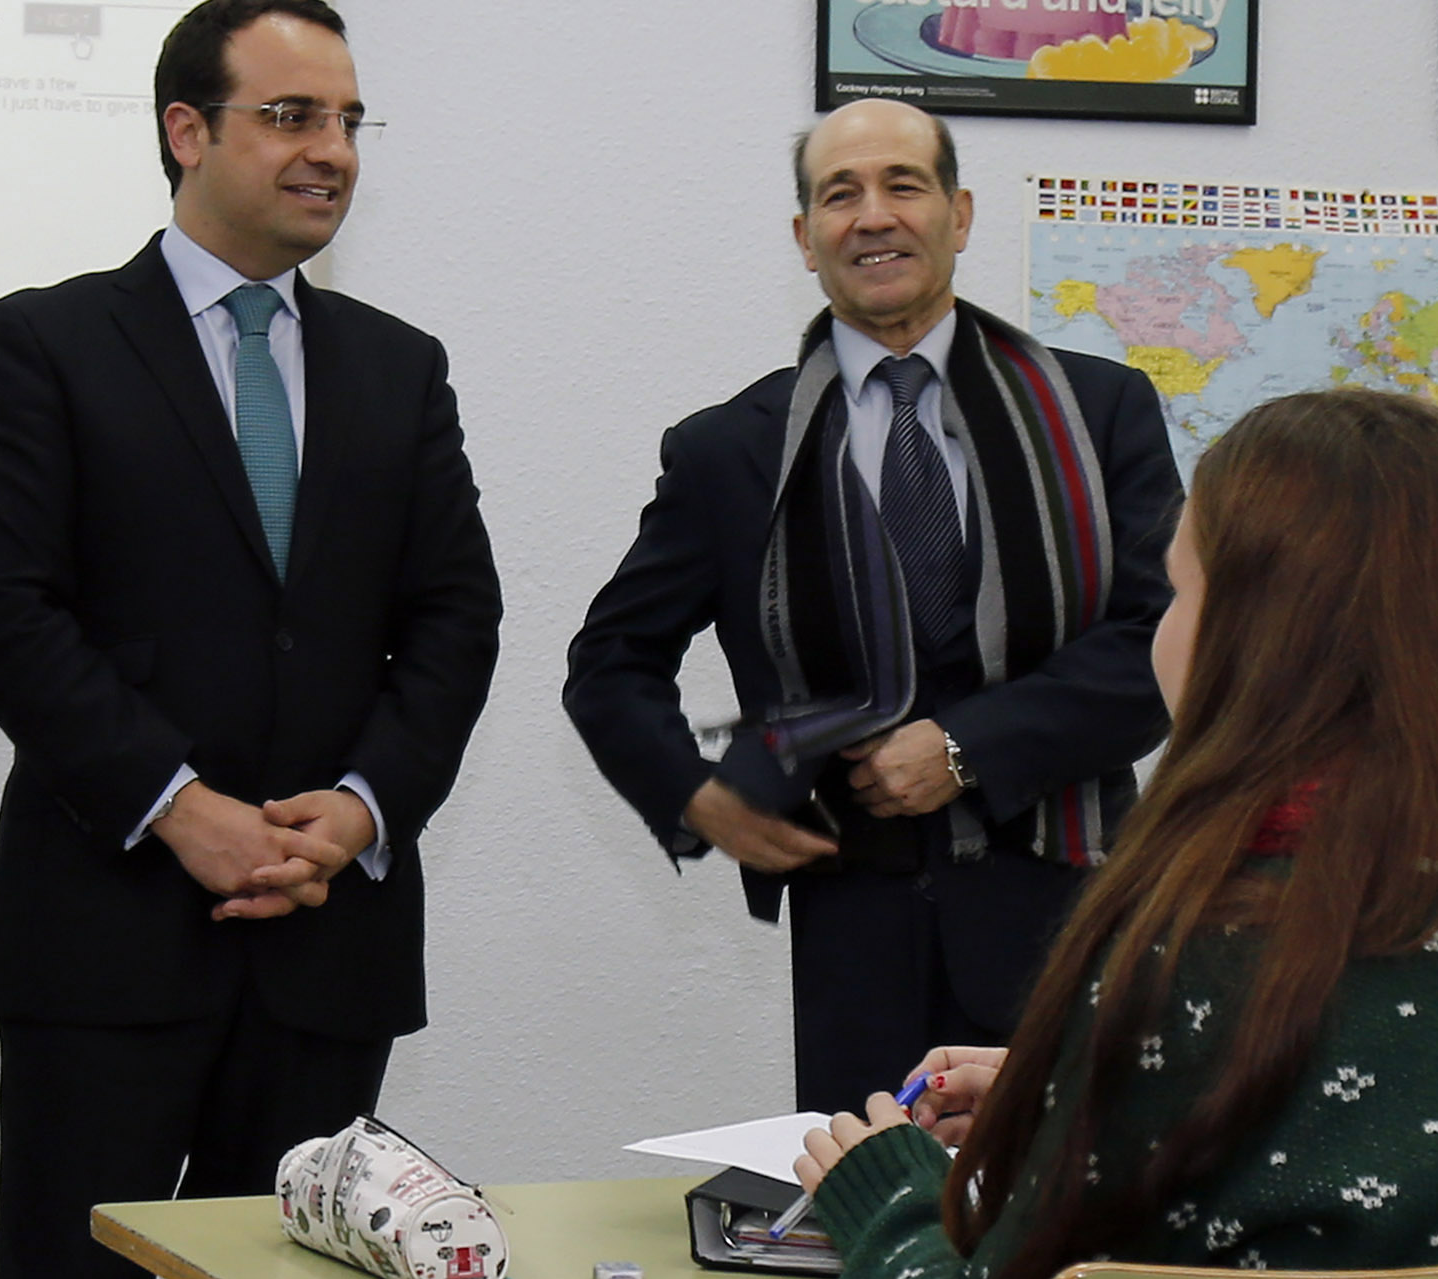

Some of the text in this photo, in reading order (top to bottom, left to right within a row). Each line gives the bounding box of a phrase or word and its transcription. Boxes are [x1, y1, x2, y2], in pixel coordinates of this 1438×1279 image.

[49, 78, 77, 92] few
[836, 83, 868, 94] Cockney
[871, 85, 902, 96] rhyming
[904, 87, 924, 96] slang
[9, 98, 39, 114] just
[44, 98, 82, 113] have
[87, 99, 102, 113] to
[107, 100, 138, 117] give
